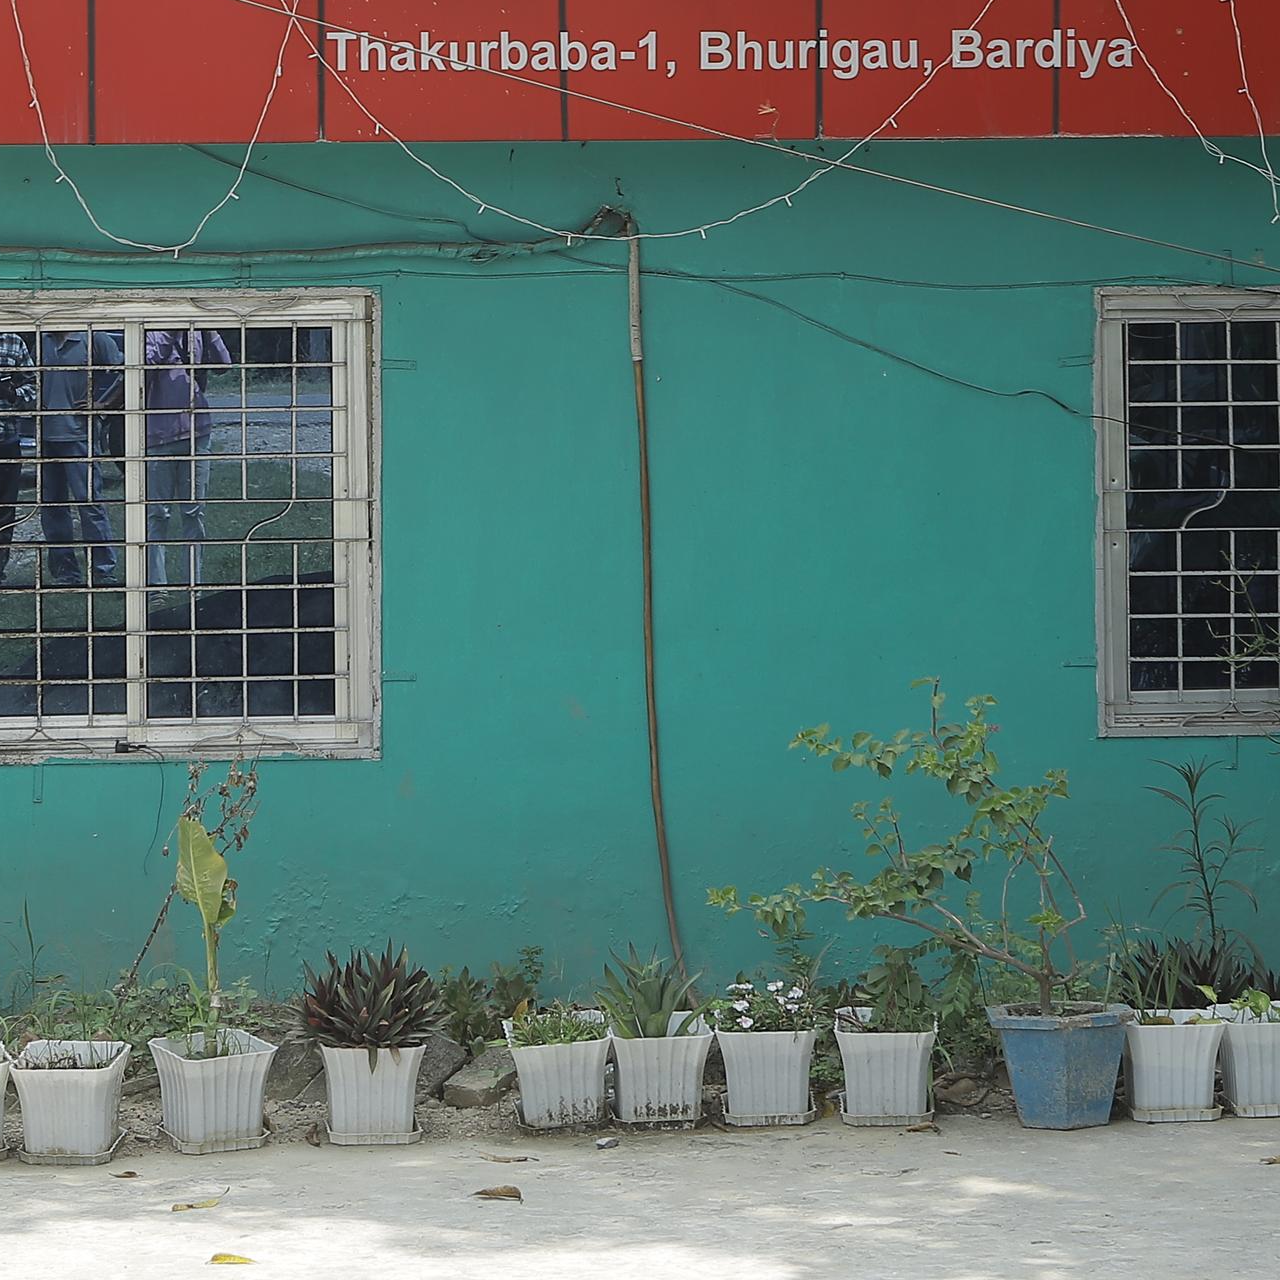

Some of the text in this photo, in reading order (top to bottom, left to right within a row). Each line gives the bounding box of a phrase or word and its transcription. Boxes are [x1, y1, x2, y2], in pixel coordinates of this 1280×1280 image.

[326, 28, 1134, 80] Thakurbaba-1, Bhurigau, Bardiya
